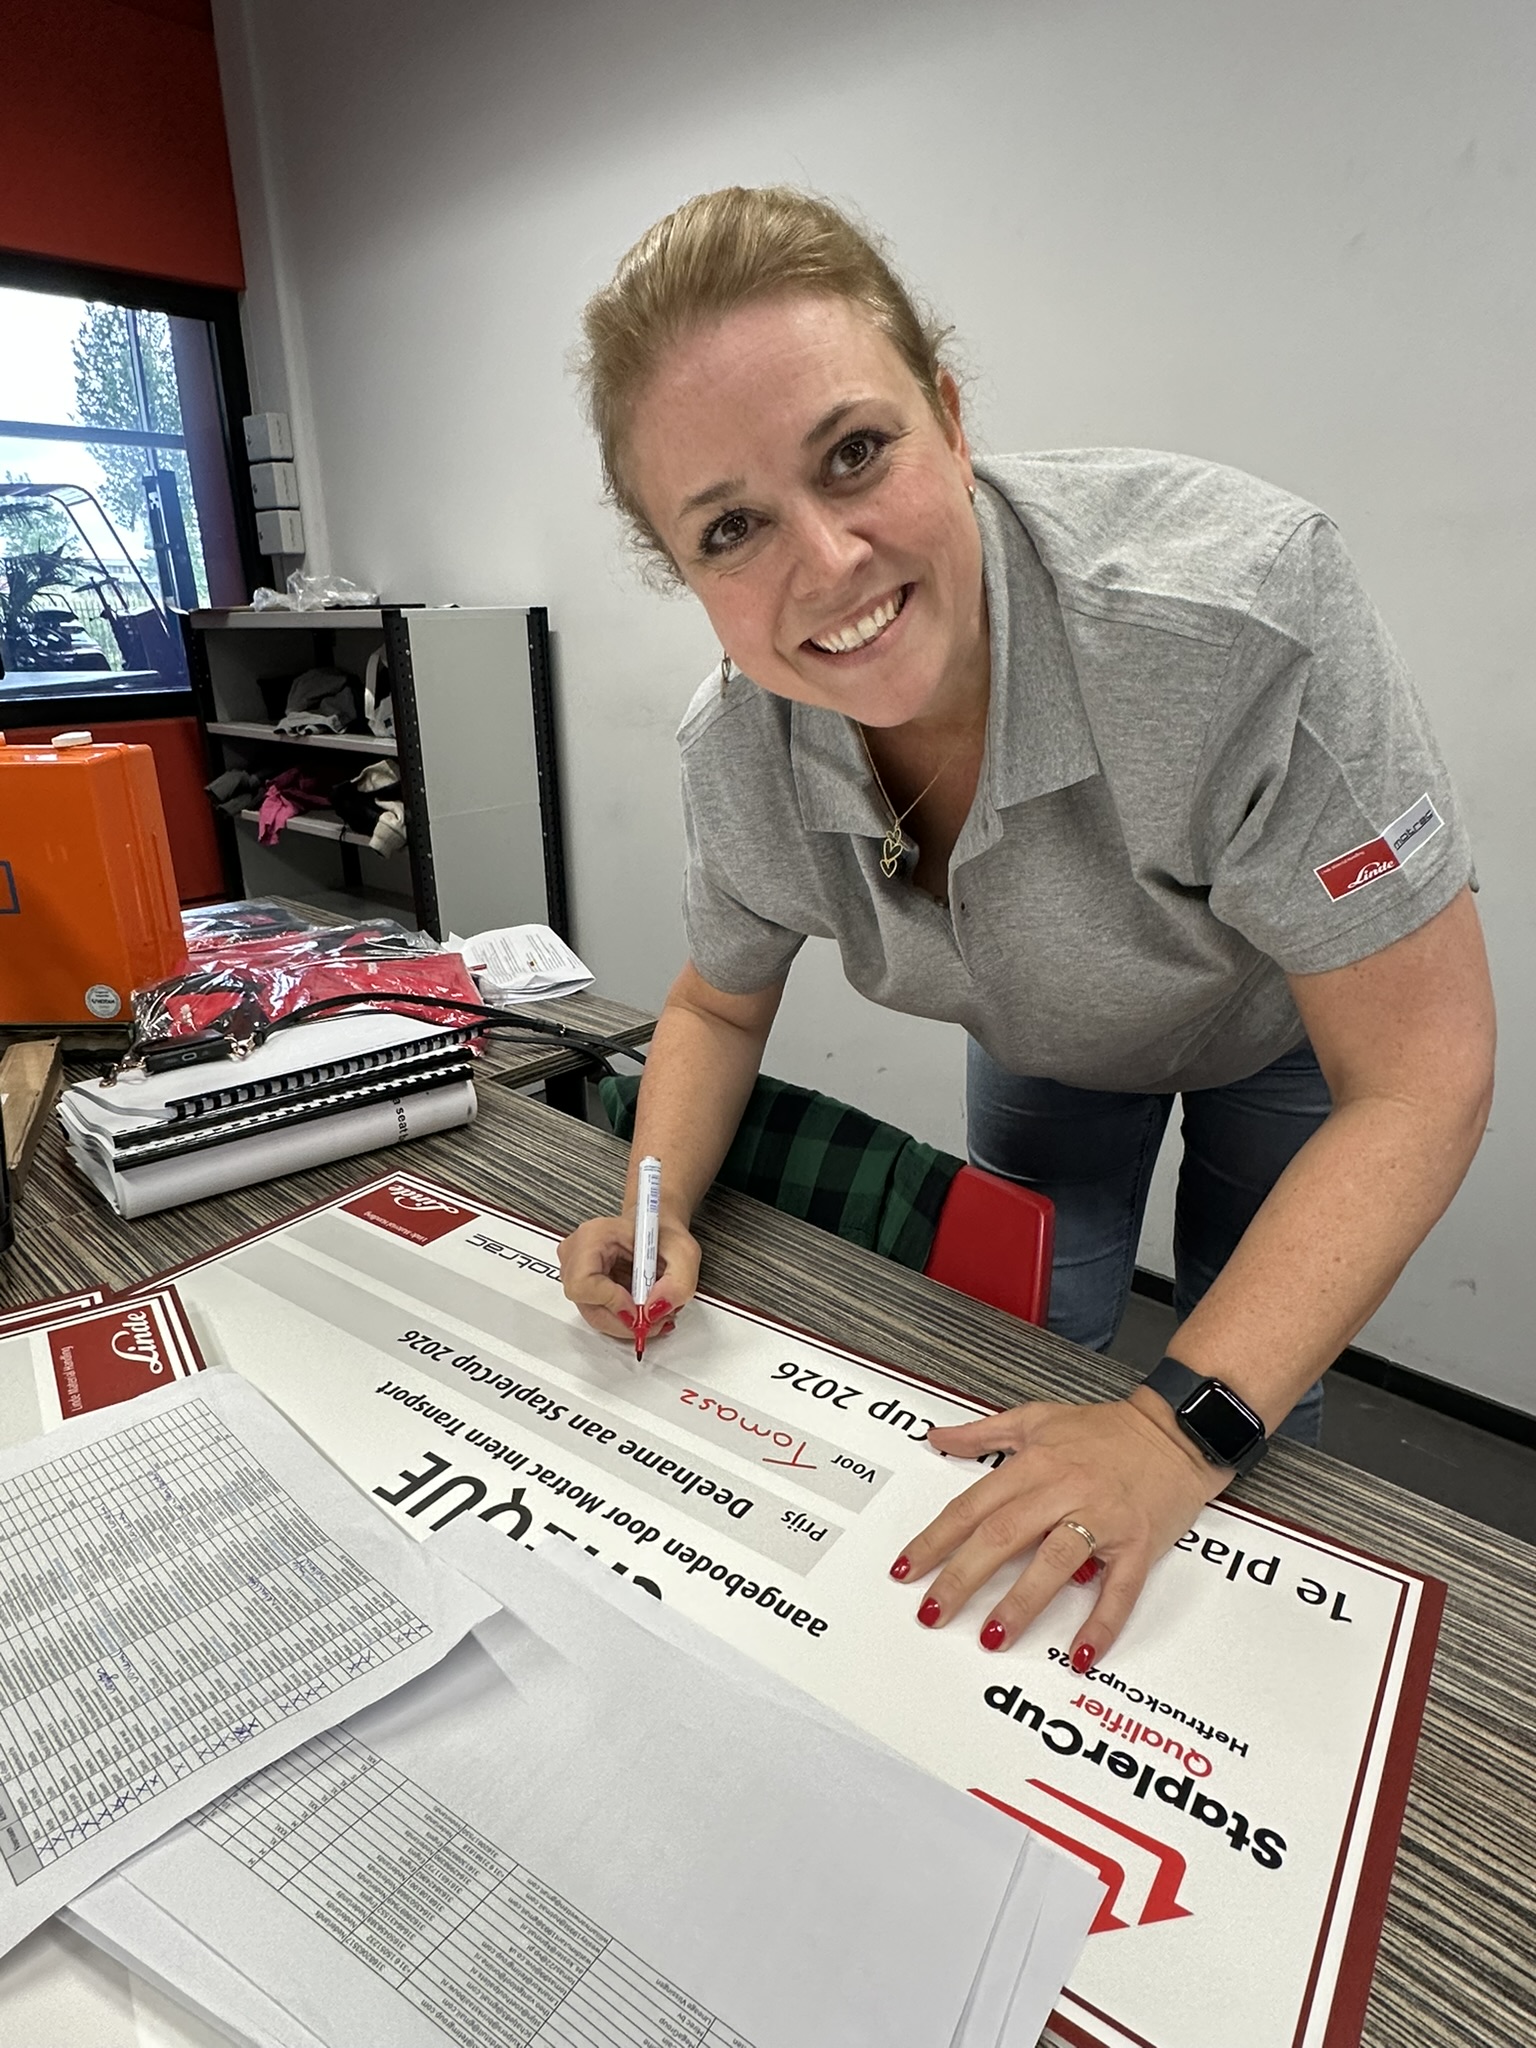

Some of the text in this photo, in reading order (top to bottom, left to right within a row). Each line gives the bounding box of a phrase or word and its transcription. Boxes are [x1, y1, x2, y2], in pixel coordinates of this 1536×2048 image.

[1394, 809, 1434, 851] motrac
[1347, 860, 1395, 889] Linde
[388, 1183, 459, 1215] Linde
[111, 1310, 164, 1375] Linde
[58, 1344, 83, 1411] Linde Material Handling
[770, 1362, 863, 1410] 2026
[397, 1328, 754, 1520] Deelname aan StaplerCup 2026
[679, 1388, 817, 1470] Tomasz
[830, 1453, 877, 1484] Voor
[373, 1379, 828, 1638] aangeboden door Motrac Intern Transport
[780, 1509, 828, 1543] Prijs
[1174, 1529, 1281, 1586] plaa
[1296, 1577, 1352, 1623] 1e
[1070, 1693, 1213, 1778] Qualifier
[983, 1685, 1288, 1870] StaplerCup
[423, 1812, 453, 1838] Nederlands
[432, 1804, 462, 1830] Nederlands
[403, 1828, 435, 1855] Nederlands
[424, 1830, 444, 1848] Engels
[375, 1853, 407, 1881] Nederlands
[397, 1854, 417, 1872] Engels
[406, 1846, 426, 1864] Engels
[356, 1871, 388, 1899] Nederlands
[365, 1862, 397, 1890] Nederlands
[324, 1899, 357, 1928] Nederlands
[335, 1889, 368, 1919] Nederlands
[357, 1889, 378, 1909] Engels
[313, 1909, 347, 1939] Nederlands
[654, 1976, 689, 2006] Vlissingen
[675, 2011, 687, 2022] bv
[684, 2018, 705, 2036] Mirec
[685, 2000, 713, 2024] Lineage
